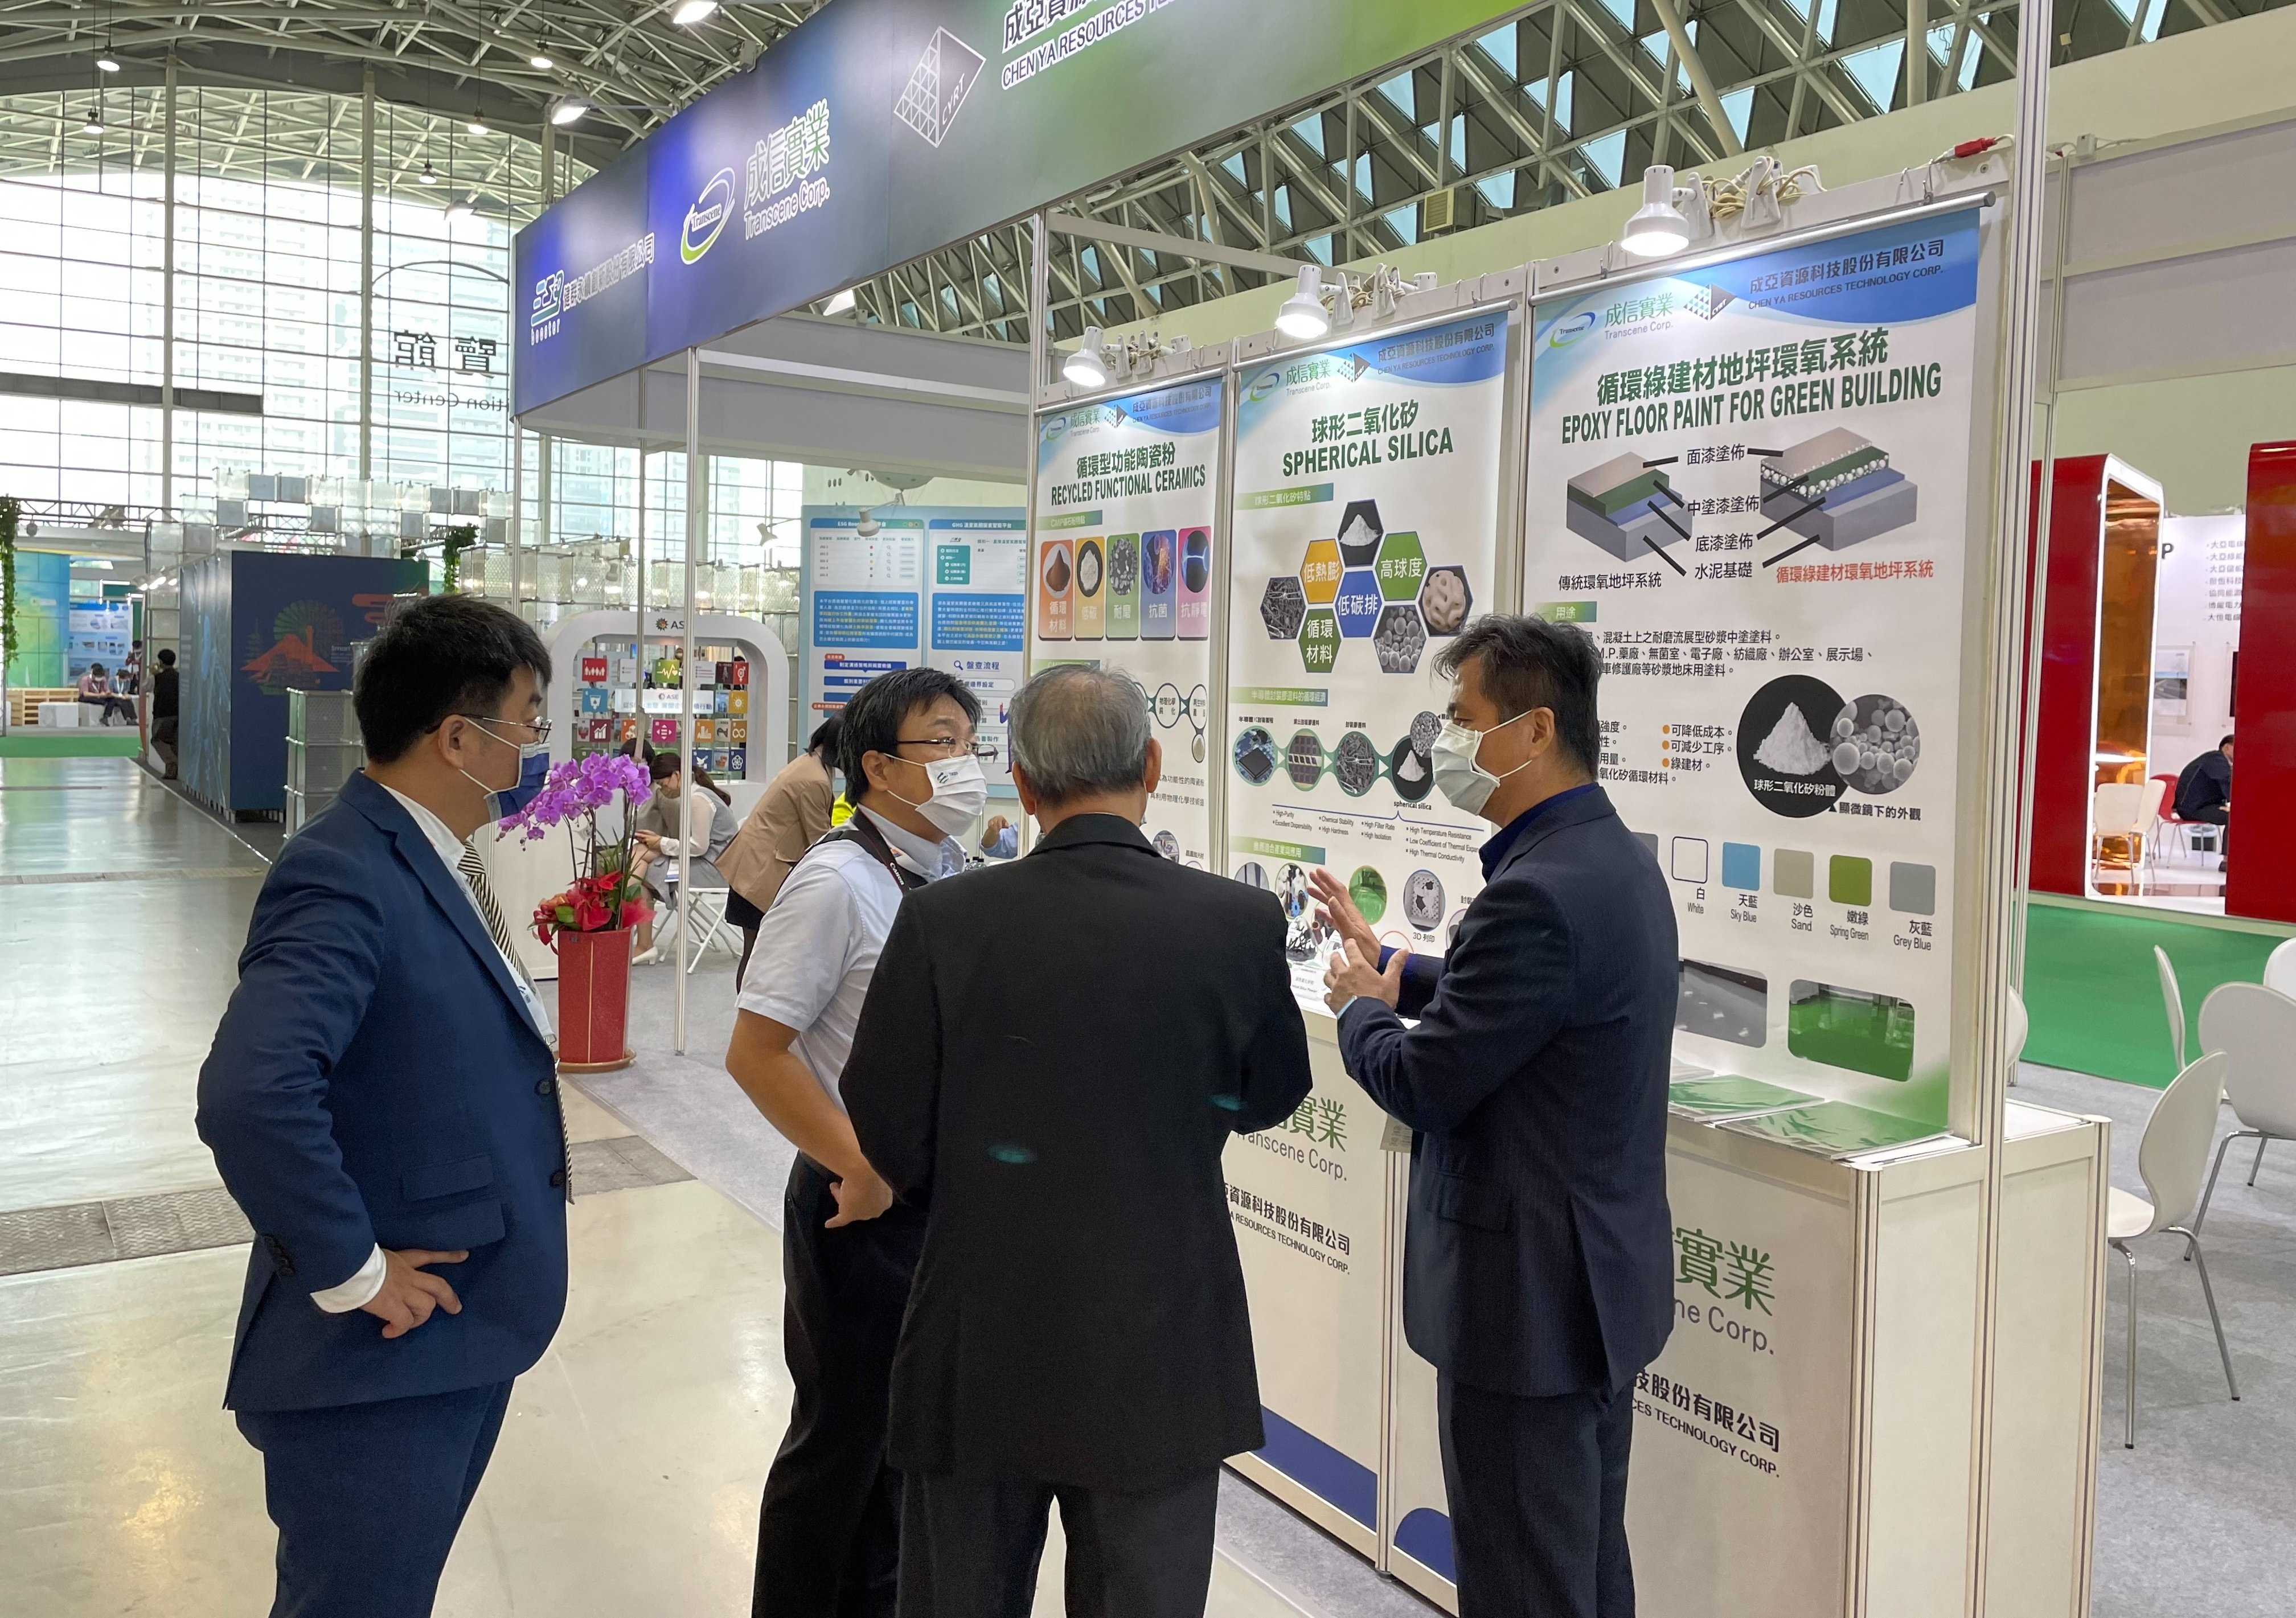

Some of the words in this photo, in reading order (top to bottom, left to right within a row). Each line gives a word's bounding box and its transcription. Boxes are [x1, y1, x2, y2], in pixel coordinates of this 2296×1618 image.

[1002, 59, 1036, 90] CHEN
[1036, 40, 1059, 71] YA
[1059, 0, 1145, 58] RESOURCES
[942, 73, 965, 126] CYRT
[744, 98, 830, 211] 成信實業
[691, 203, 721, 232] Transcene
[744, 192, 798, 240] Transcene
[799, 176, 830, 212] Corp.
[1750, 239, 1944, 294] 成亞資源科技股份有限公司
[1749, 298, 1772, 310] CHEN
[1774, 295, 1786, 304] YA
[1788, 284, 1843, 303] RESOURCES
[1845, 271, 1910, 292] TECHNOLOGY
[1912, 264, 1944, 278] CORP.
[1604, 292, 1674, 328] 成信實業
[531, 318, 560, 346] booster
[1560, 325, 1585, 335] Transcene
[1604, 326, 1647, 340] Transcene
[1650, 320, 1674, 334] Corp.
[1378, 322, 1494, 363] 成亞資源科技股份有限公司
[1377, 366, 1392, 375] CHEN
[1402, 356, 1436, 370] RESOURCES
[1437, 348, 1475, 362] TECHNOLOGY
[1476, 343, 1495, 354] CORP.
[1597, 327, 1889, 406] 循環綠建材地坪環氧系統
[1286, 359, 1331, 387] 成信實業
[1286, 385, 1315, 396] Transcene
[1316, 380, 1331, 391] Corp.
[1562, 409, 1612, 444] EPOXY
[1616, 402, 1668, 437] FLOOR
[1674, 393, 1725, 430] PAINT
[1729, 388, 1765, 423] FOR
[1770, 377, 1835, 418] GREEN
[1841, 362, 1942, 409] BUILDING
[1070, 407, 1100, 428] 成信實業
[1311, 399, 1419, 443] 球形二氧化矽
[1076, 442, 1176, 479] 循環型功能陶瓷粉
[1282, 438, 1382, 477] SPHERICAL
[1387, 426, 1454, 461] SILICA
[1687, 443, 1745, 466] 面漆塗佈
[1051, 481, 1093, 506] RECYCLED
[1095, 473, 1153, 500] FUNCTIONAL
[1155, 464, 1206, 492] CERAMICS
[1687, 494, 1760, 517] 中塗漆塗佈
[1695, 532, 1753, 553] 底漆塗佈
[1303, 561, 1340, 583] 低熱膨
[1380, 557, 1422, 580] 高球度
[1695, 561, 1753, 580] 水泥基礎
[1776, 559, 1934, 584] 循環綠建材環氧地坪系統
[1558, 571, 1662, 592] 傳統環氧地坪系統
[1049, 601, 1067, 615] 循環
[1113, 603, 1131, 619] 耐磨
[1148, 603, 1168, 618] 抗菌
[1180, 602, 1208, 618] 抗靜電
[1338, 593, 1379, 617] 低碳排
[1556, 606, 1576, 619] 用途
[1049, 619, 1067, 634] 材料
[1307, 618, 1334, 639] 循環
[1306, 643, 1333, 664] 材料
[1597, 720, 1627, 734] 強度。
[1671, 724, 1732, 739] 可降低成本。
[1671, 740, 1732, 755] 可減少工序。
[1600, 753, 1626, 766] 用量。
[1670, 757, 1710, 771] 綠建材。
[1599, 767, 1676, 785] 氧化矽循環材料。
[1753, 778, 1836, 797] 球形二氧化矽粉體
[1276, 810, 1295, 819] High-Purity
[1393, 800, 1417, 810] spherical
[1418, 802, 1432, 810] silica
[1839, 801, 1921, 821] 顯微鏡下的外觀
[1364, 821, 1374, 830] High
[1409, 827, 1420, 835] High
[1420, 828, 1448, 837] Temperature
[1409, 848, 1420, 857] High
[1420, 849, 1438, 858] Thermal
[1437, 851, 1465, 864] Conductivity
[1418, 839, 1442, 848] Coefficient
[1448, 842, 1466, 851] Thermal
[1466, 845, 1479, 853] Expan
[1696, 887, 1705, 900] 白
[1739, 893, 1758, 909] 天藍
[1687, 902, 1704, 914] White
[1731, 909, 1742, 922] Sky
[1743, 910, 1757, 922] Blue
[1793, 902, 1813, 918] 沙色
[1847, 909, 1869, 926] 嫩綠
[1791, 918, 1813, 931] Sand
[1830, 925, 1849, 940] Spring
[1850, 927, 1869, 941] Green
[1909, 919, 1932, 937] 灰藍
[1412, 931, 1422, 941] 3D
[1893, 934, 1912, 950] Grey
[1913, 937, 1932, 950] Blue
[1276, 1096, 1347, 1152] 實業
[1236, 1130, 1305, 1164] anscene
[1309, 1148, 1348, 1181] Corp.
[1235, 1213, 1276, 1240] RESOURCES
[1277, 1232, 1326, 1263] TECHNOLOGY
[1327, 1259, 1350, 1275] CORP.
[1708, 1306, 1775, 1356] Corp.
[1654, 1408, 1737, 1457] TECHNOLOGY
[1740, 1449, 1780, 1479] CORP.
